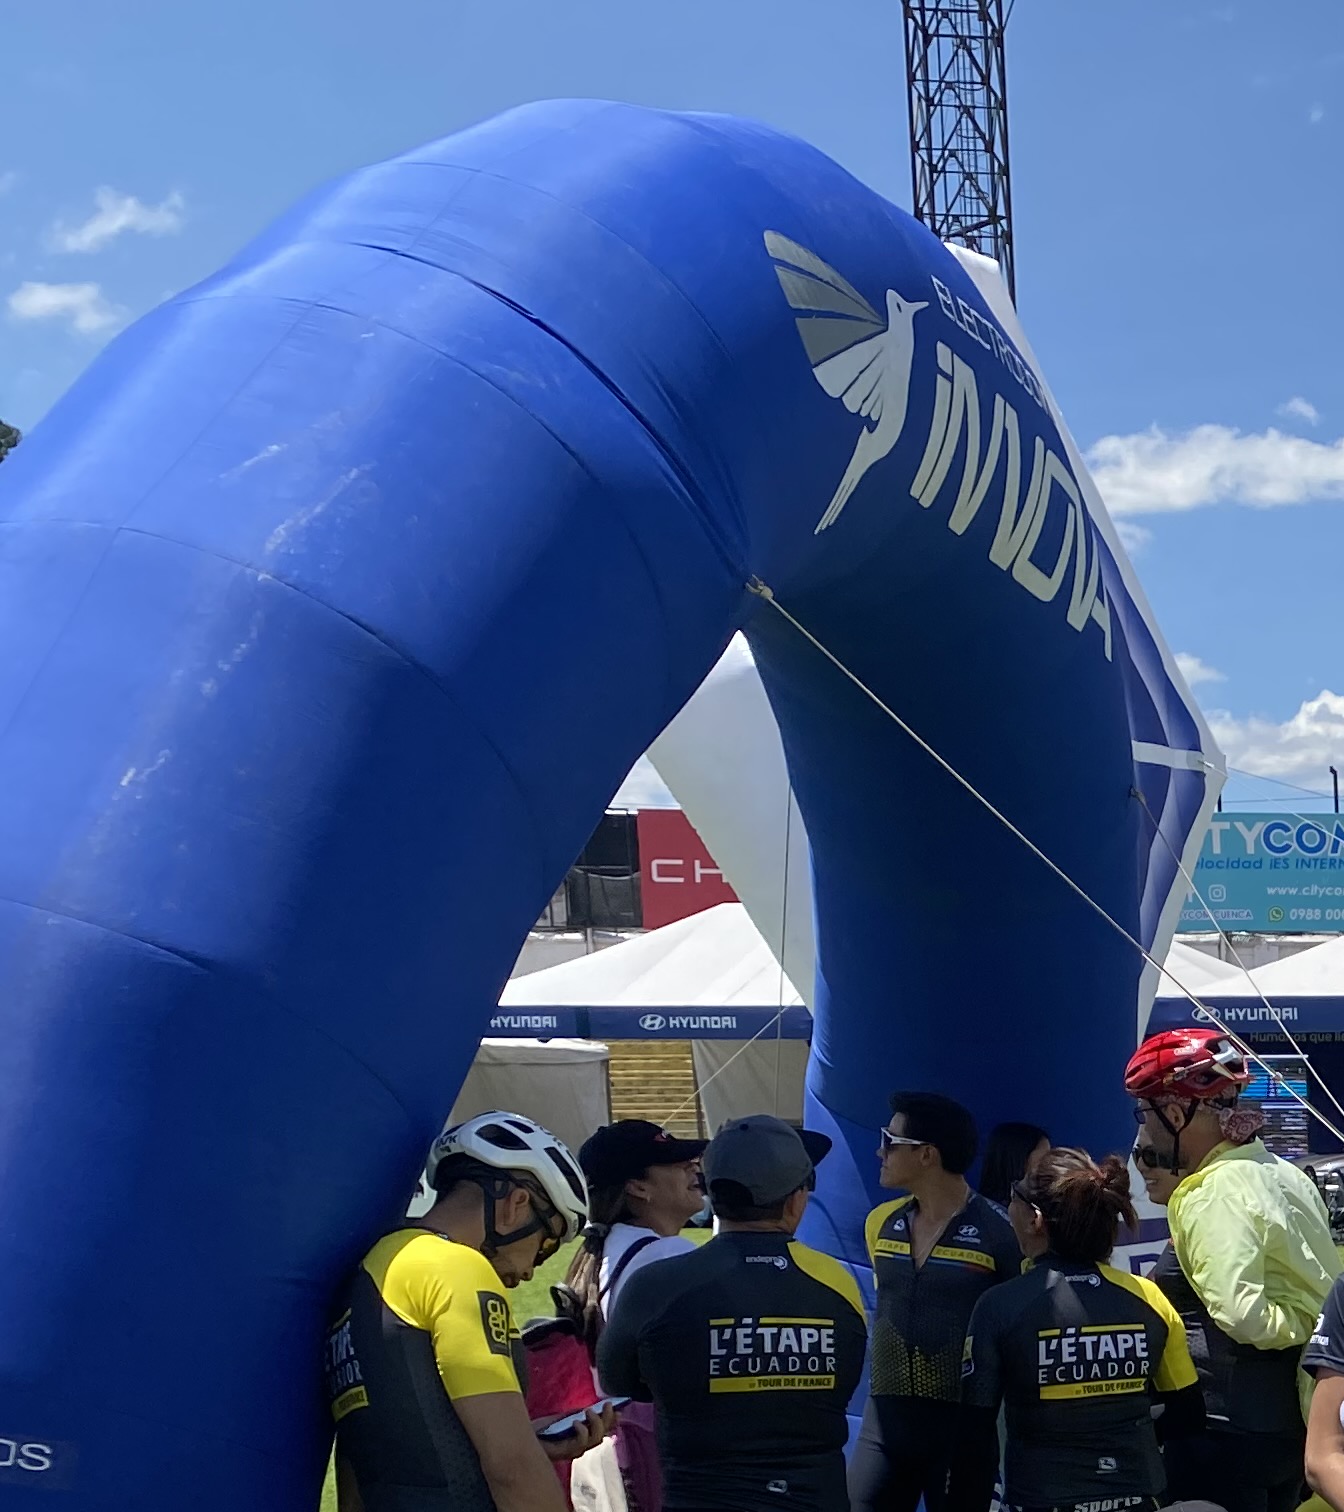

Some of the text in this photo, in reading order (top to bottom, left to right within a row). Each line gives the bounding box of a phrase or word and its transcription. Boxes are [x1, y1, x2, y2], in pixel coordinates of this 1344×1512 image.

[669, 1016, 737, 1029] HYUNDAI
[1224, 1007, 1298, 1021] HYUNDAI
[709, 1318, 835, 1355] L'ÉTAPE
[1038, 1327, 1149, 1366] L'ÉTAPE
[709, 1356, 836, 1375] ECUADOR
[1038, 1360, 1150, 1384] ECUADOR
[757, 1377, 832, 1388] TOUR DE FRANCE
